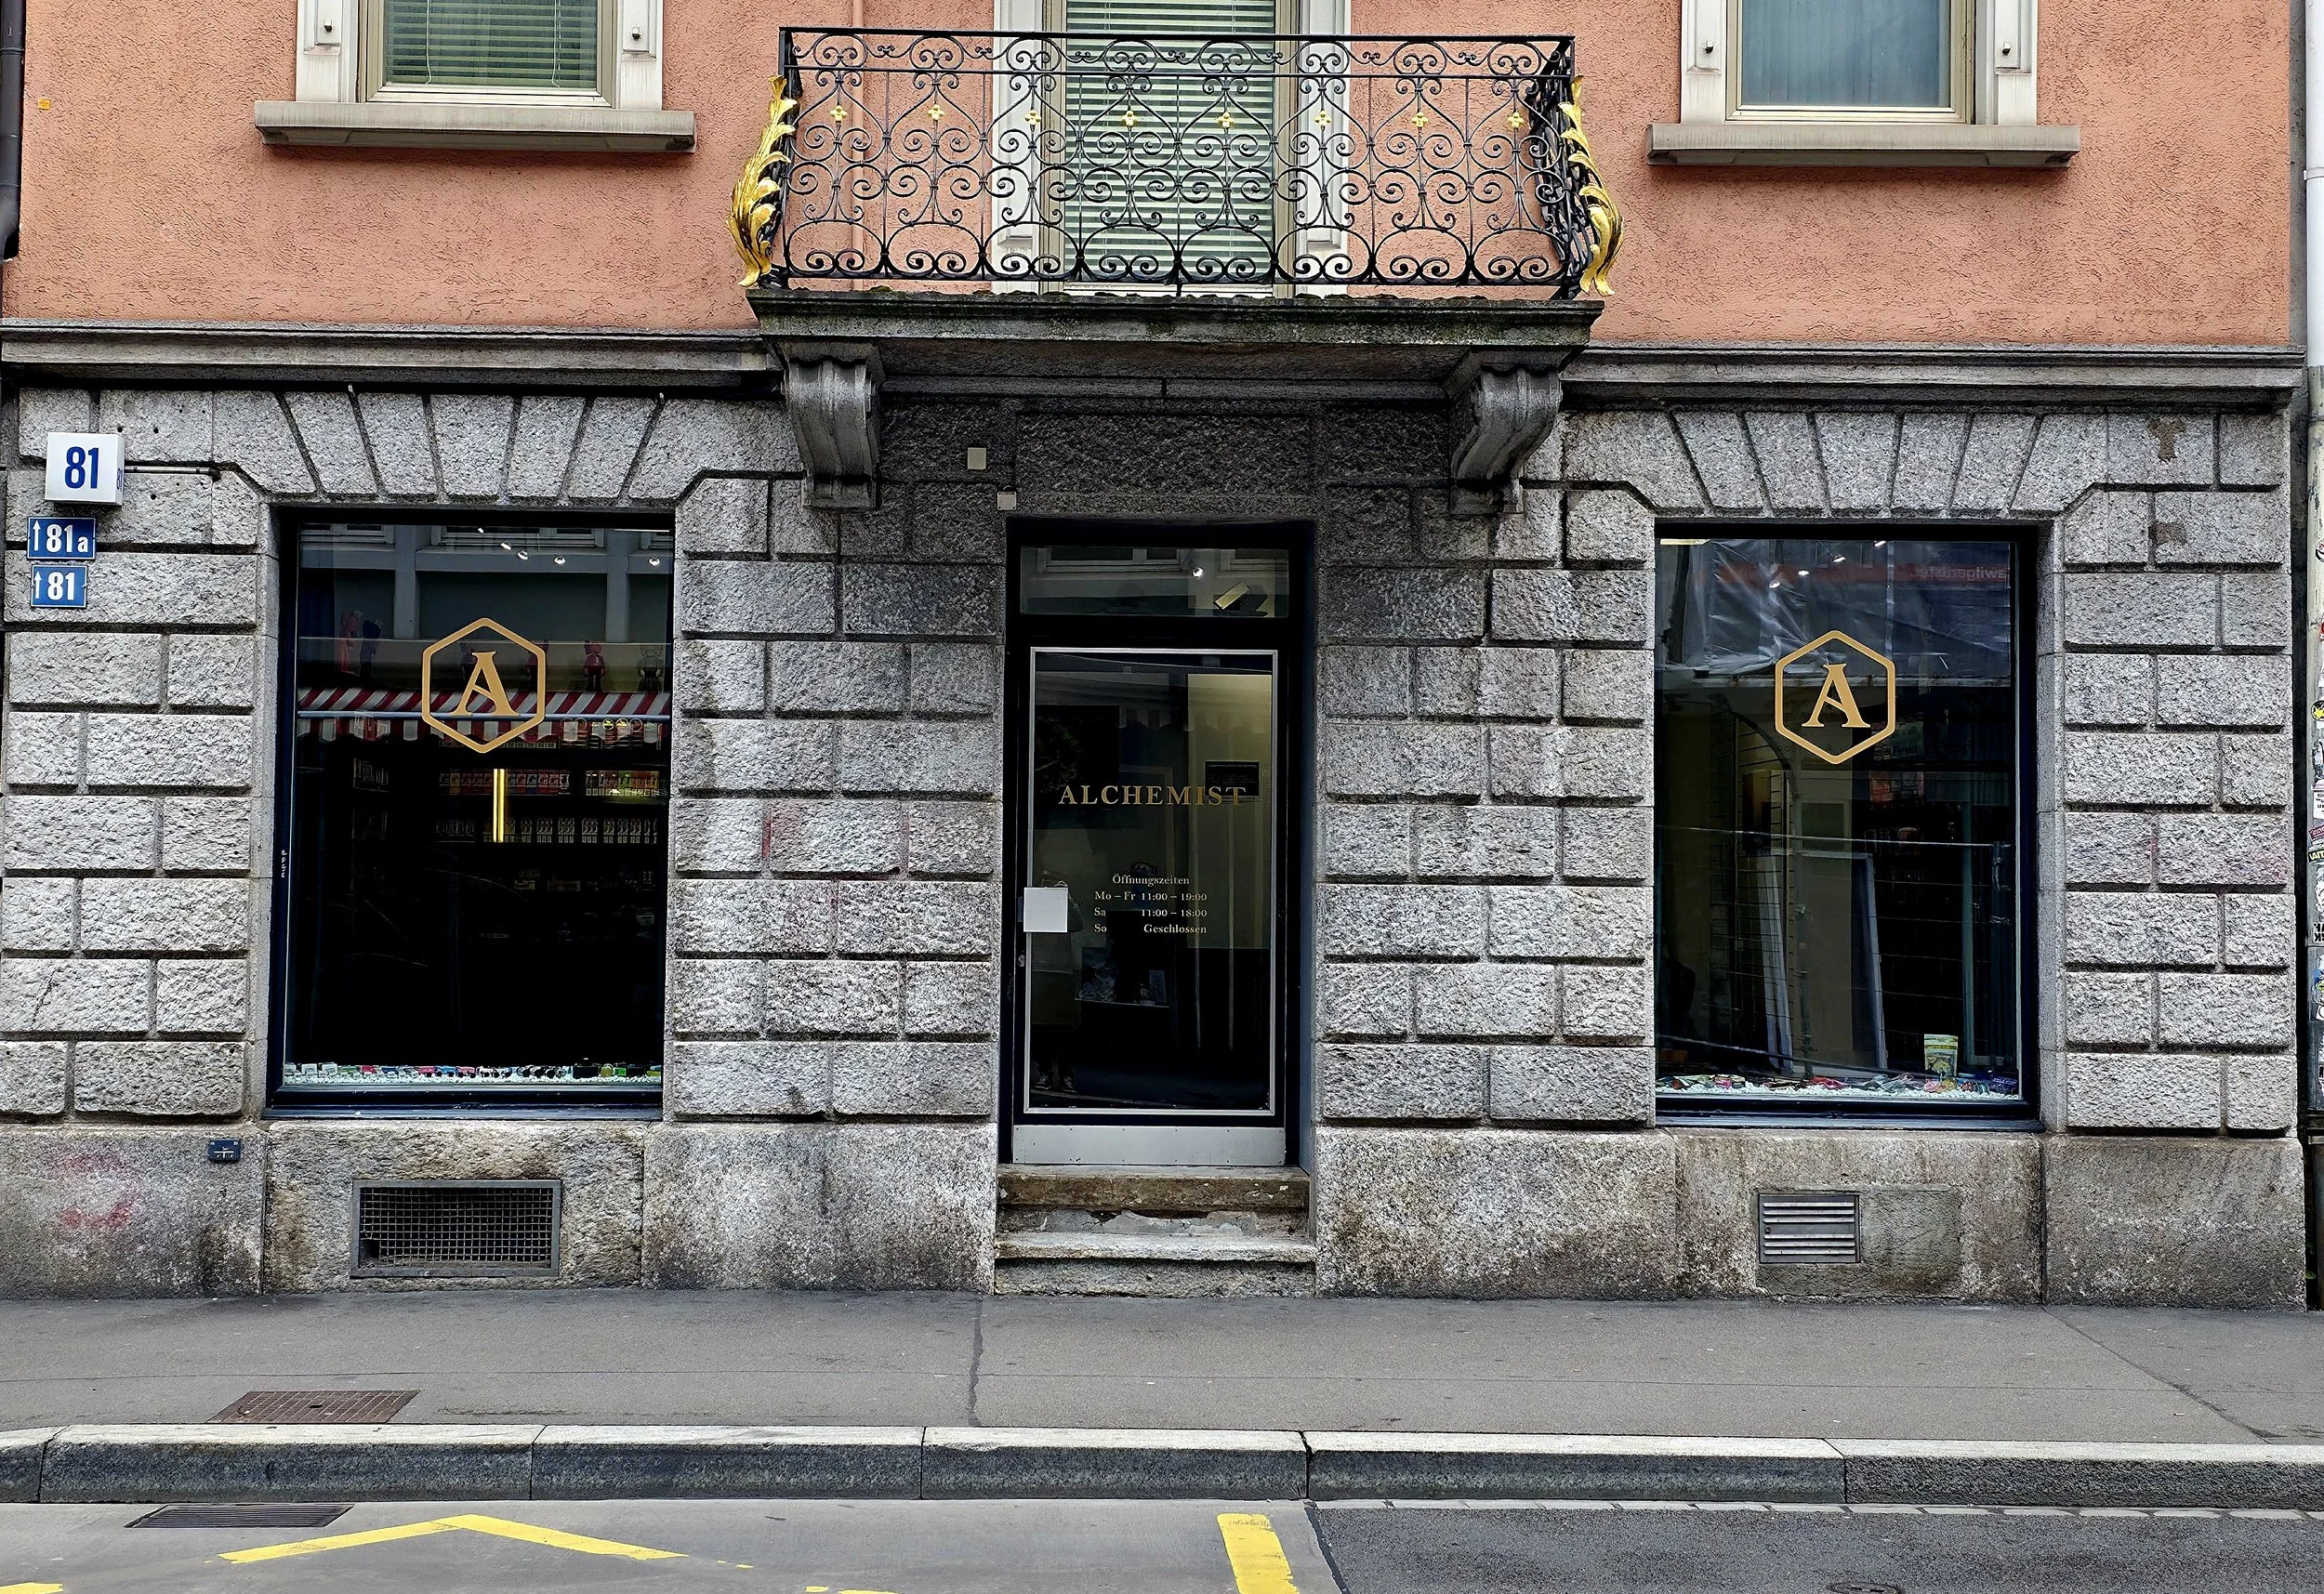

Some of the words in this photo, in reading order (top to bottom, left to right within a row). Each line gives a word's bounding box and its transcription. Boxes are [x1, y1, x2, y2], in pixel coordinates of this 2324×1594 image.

[64, 446, 99, 489] 81
[46, 523, 88, 553] 81a
[47, 572, 74, 600] 81
[449, 651, 519, 717] A
[1802, 663, 1871, 728] A
[1058, 784, 1247, 806] ALCHEMIST
[1112, 874, 1190, 887] Öffnungszeiten
[1094, 891, 1112, 901] Mo
[1124, 891, 1136, 901] Fr
[1142, 892, 1169, 901] 11:00
[1181, 892, 1208, 901] 19:00
[1093, 907, 1106, 916] Sa
[1142, 909, 1169, 917] 11:00
[1181, 909, 1208, 917] 18:00
[1094, 924, 1107, 933] So
[1143, 923, 1208, 934] Geschlossen
